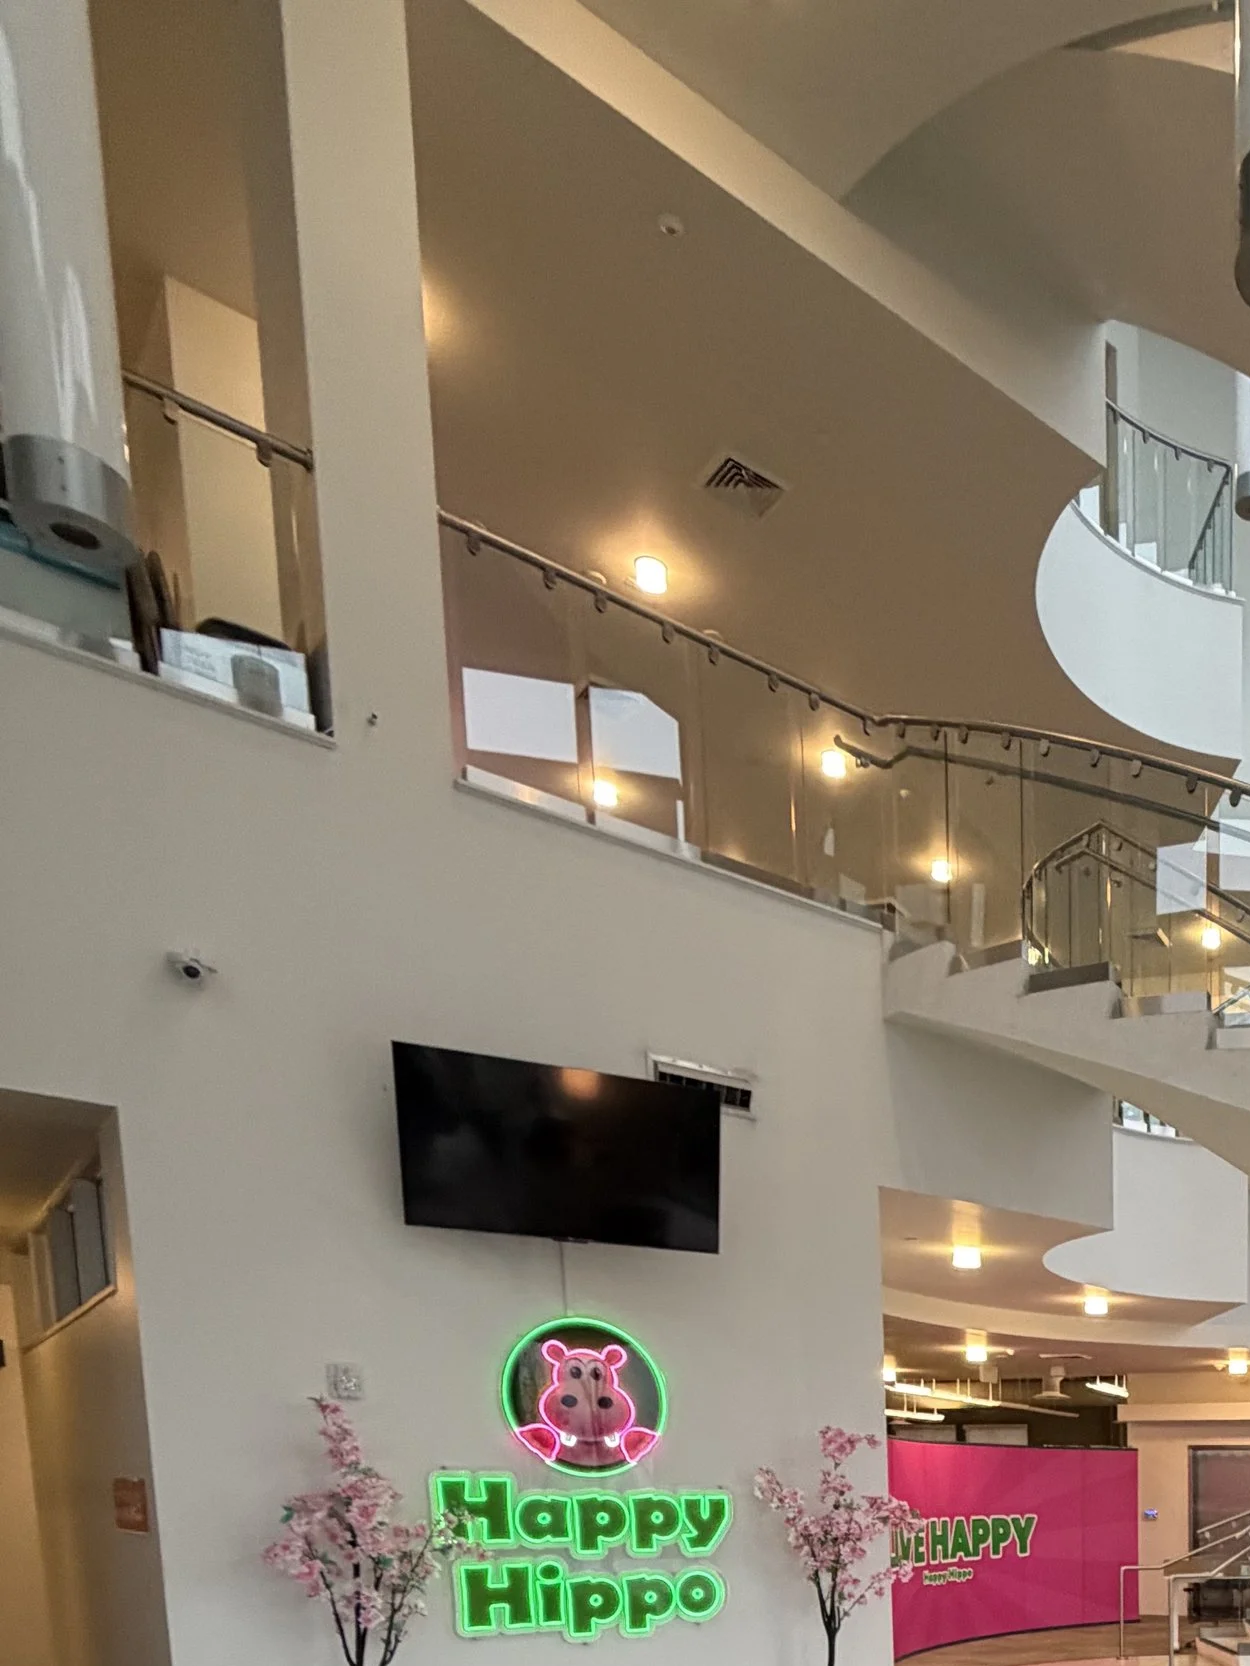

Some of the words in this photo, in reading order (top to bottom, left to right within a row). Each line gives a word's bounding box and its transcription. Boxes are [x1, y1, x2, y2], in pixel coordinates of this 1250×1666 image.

[432, 1474, 732, 1557] Happy
[928, 1514, 1037, 1564] HAPPY
[458, 1561, 726, 1639] Hippo
